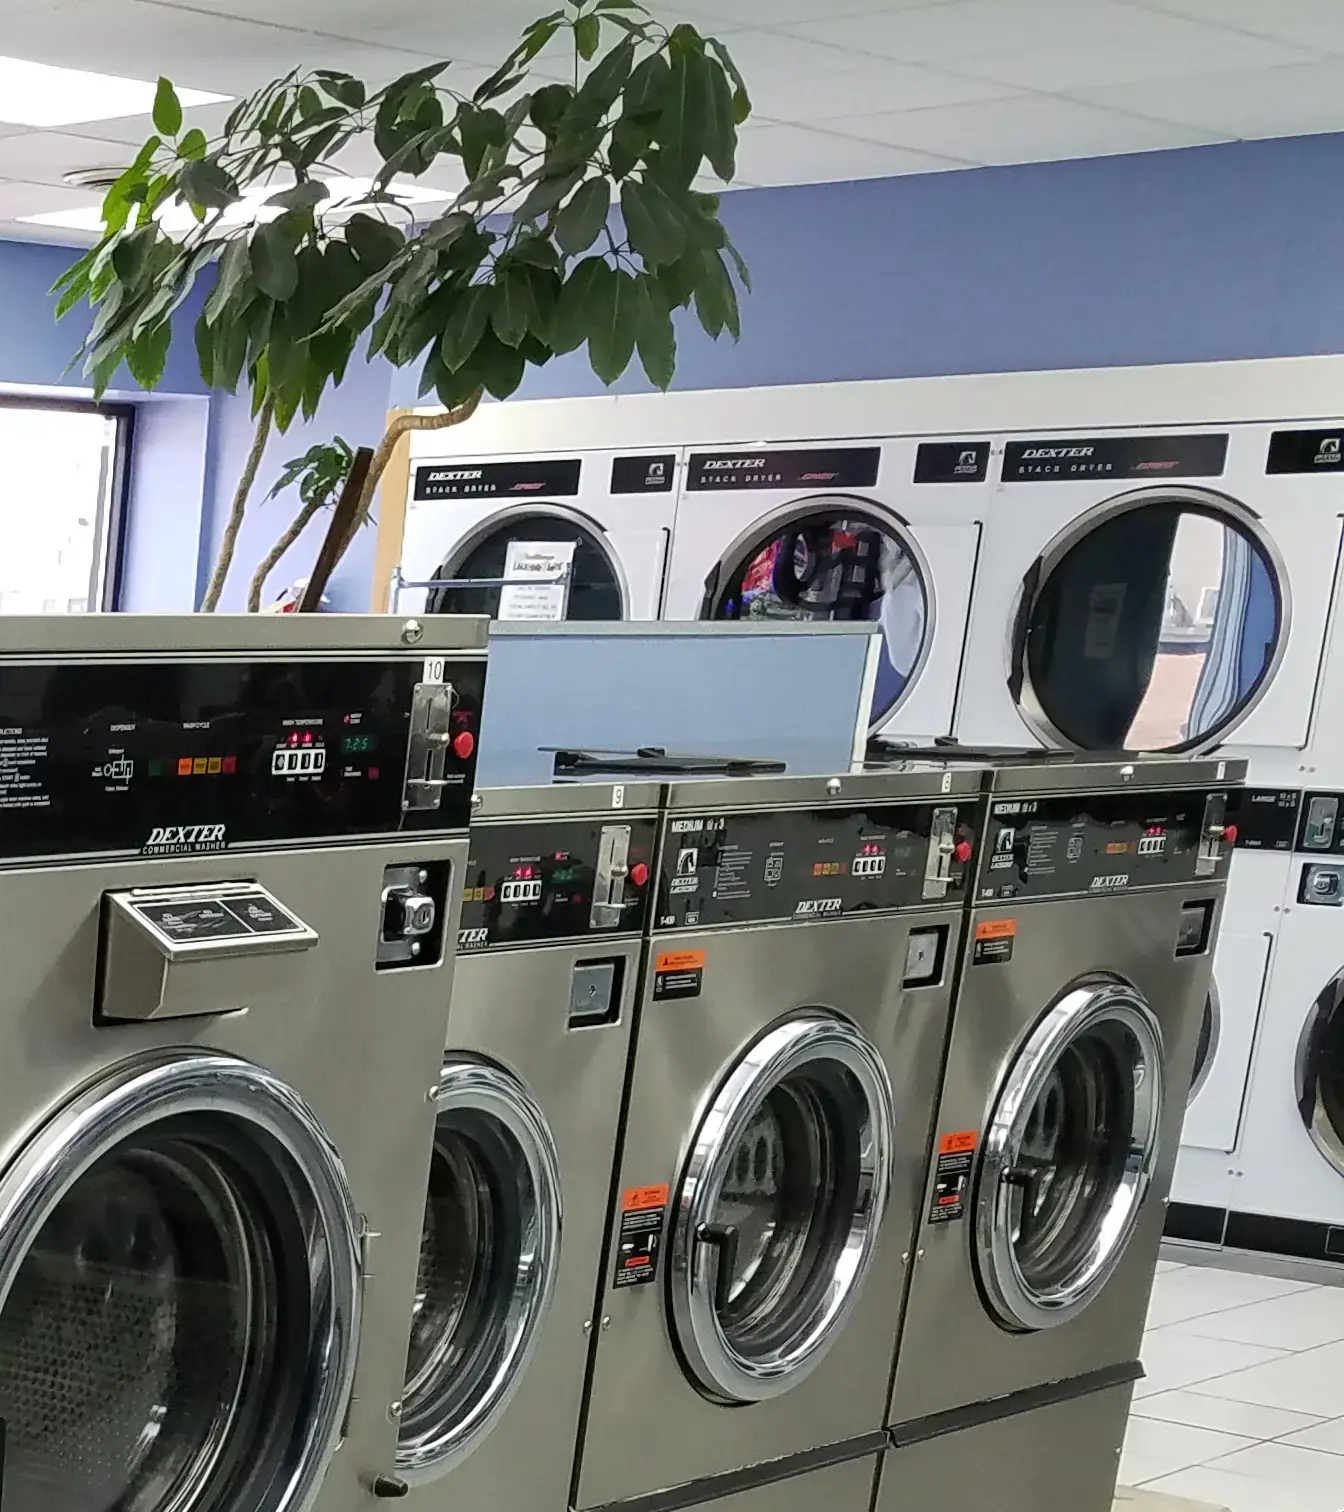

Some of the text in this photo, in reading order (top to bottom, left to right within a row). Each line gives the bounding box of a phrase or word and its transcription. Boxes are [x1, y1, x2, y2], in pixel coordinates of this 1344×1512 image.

[1021, 447, 1094, 459] DEXTER
[703, 459, 766, 469] DEXTER
[427, 470, 482, 481] DEXTER
[428, 661, 442, 680] 10
[672, 820, 703, 832] MEDIUM
[146, 824, 226, 845] DEXTER
[143, 842, 226, 854] COMMERCIAL WASHER
[1092, 875, 1128, 887] DEXTER
[795, 899, 842, 913] DEXTER
